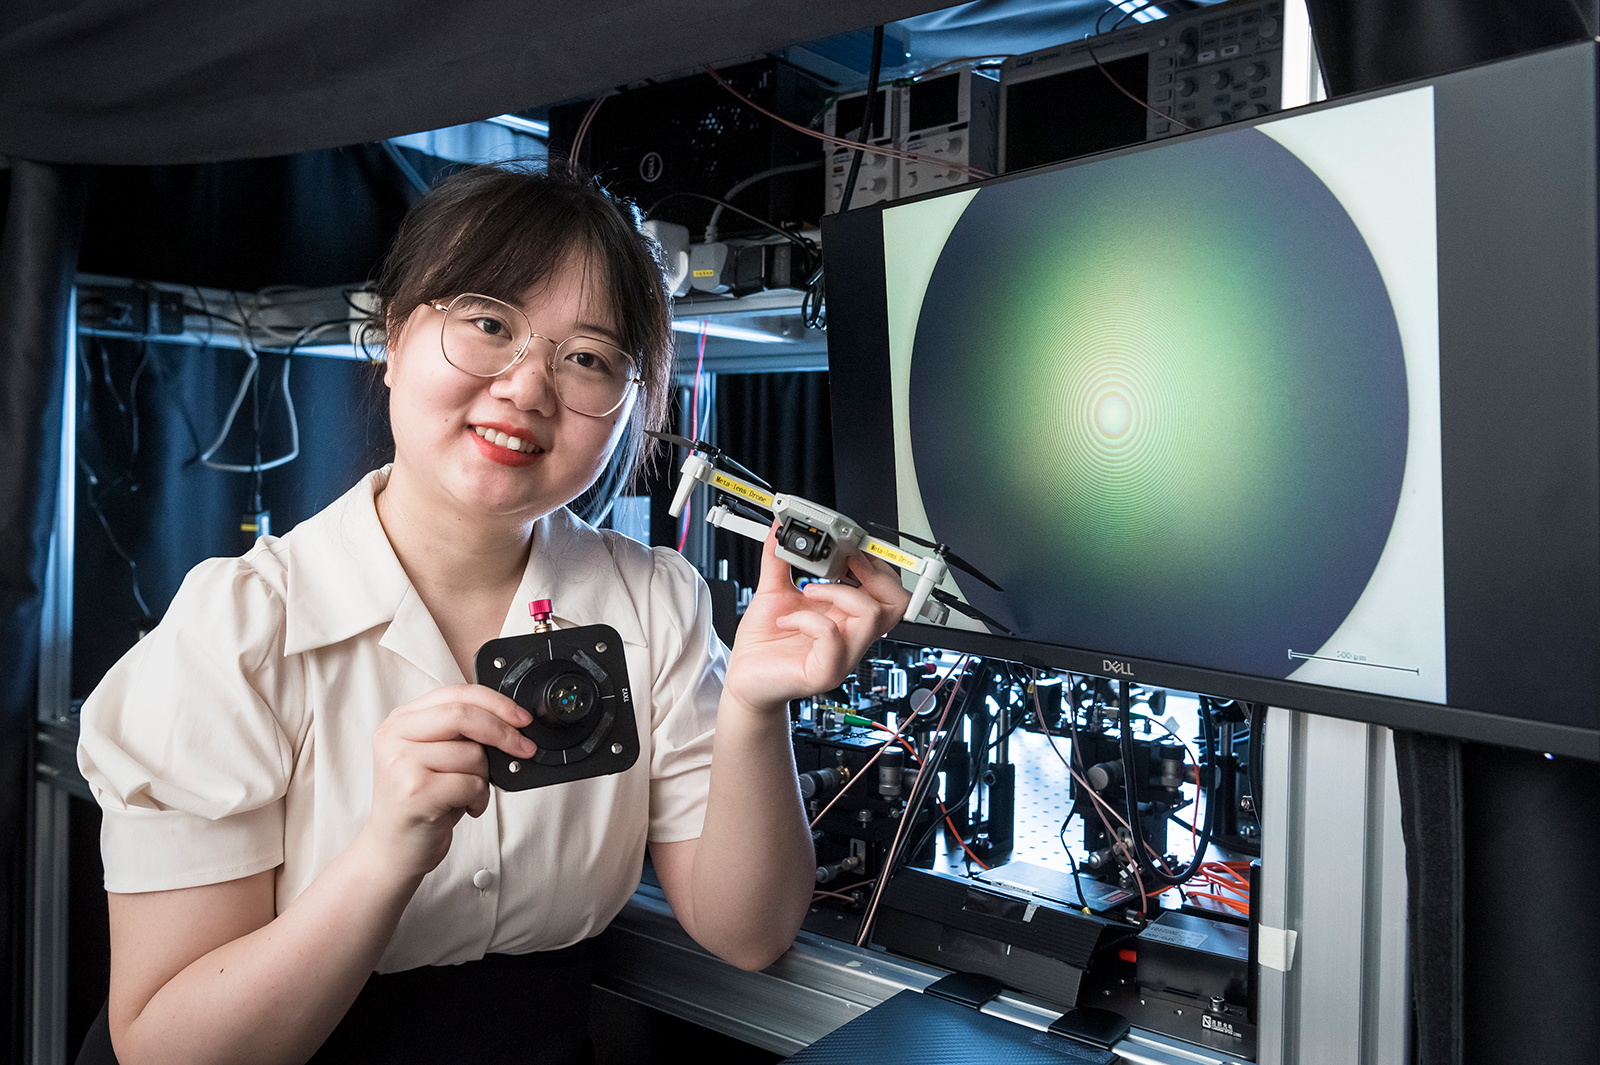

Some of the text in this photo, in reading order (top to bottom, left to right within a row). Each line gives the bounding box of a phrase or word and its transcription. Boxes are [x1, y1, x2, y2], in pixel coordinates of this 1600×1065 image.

[716, 475, 767, 503] Meta-lens Drone
[870, 543, 915, 567] Meta-lens Drone
[1102, 659, 1135, 676] DELL
